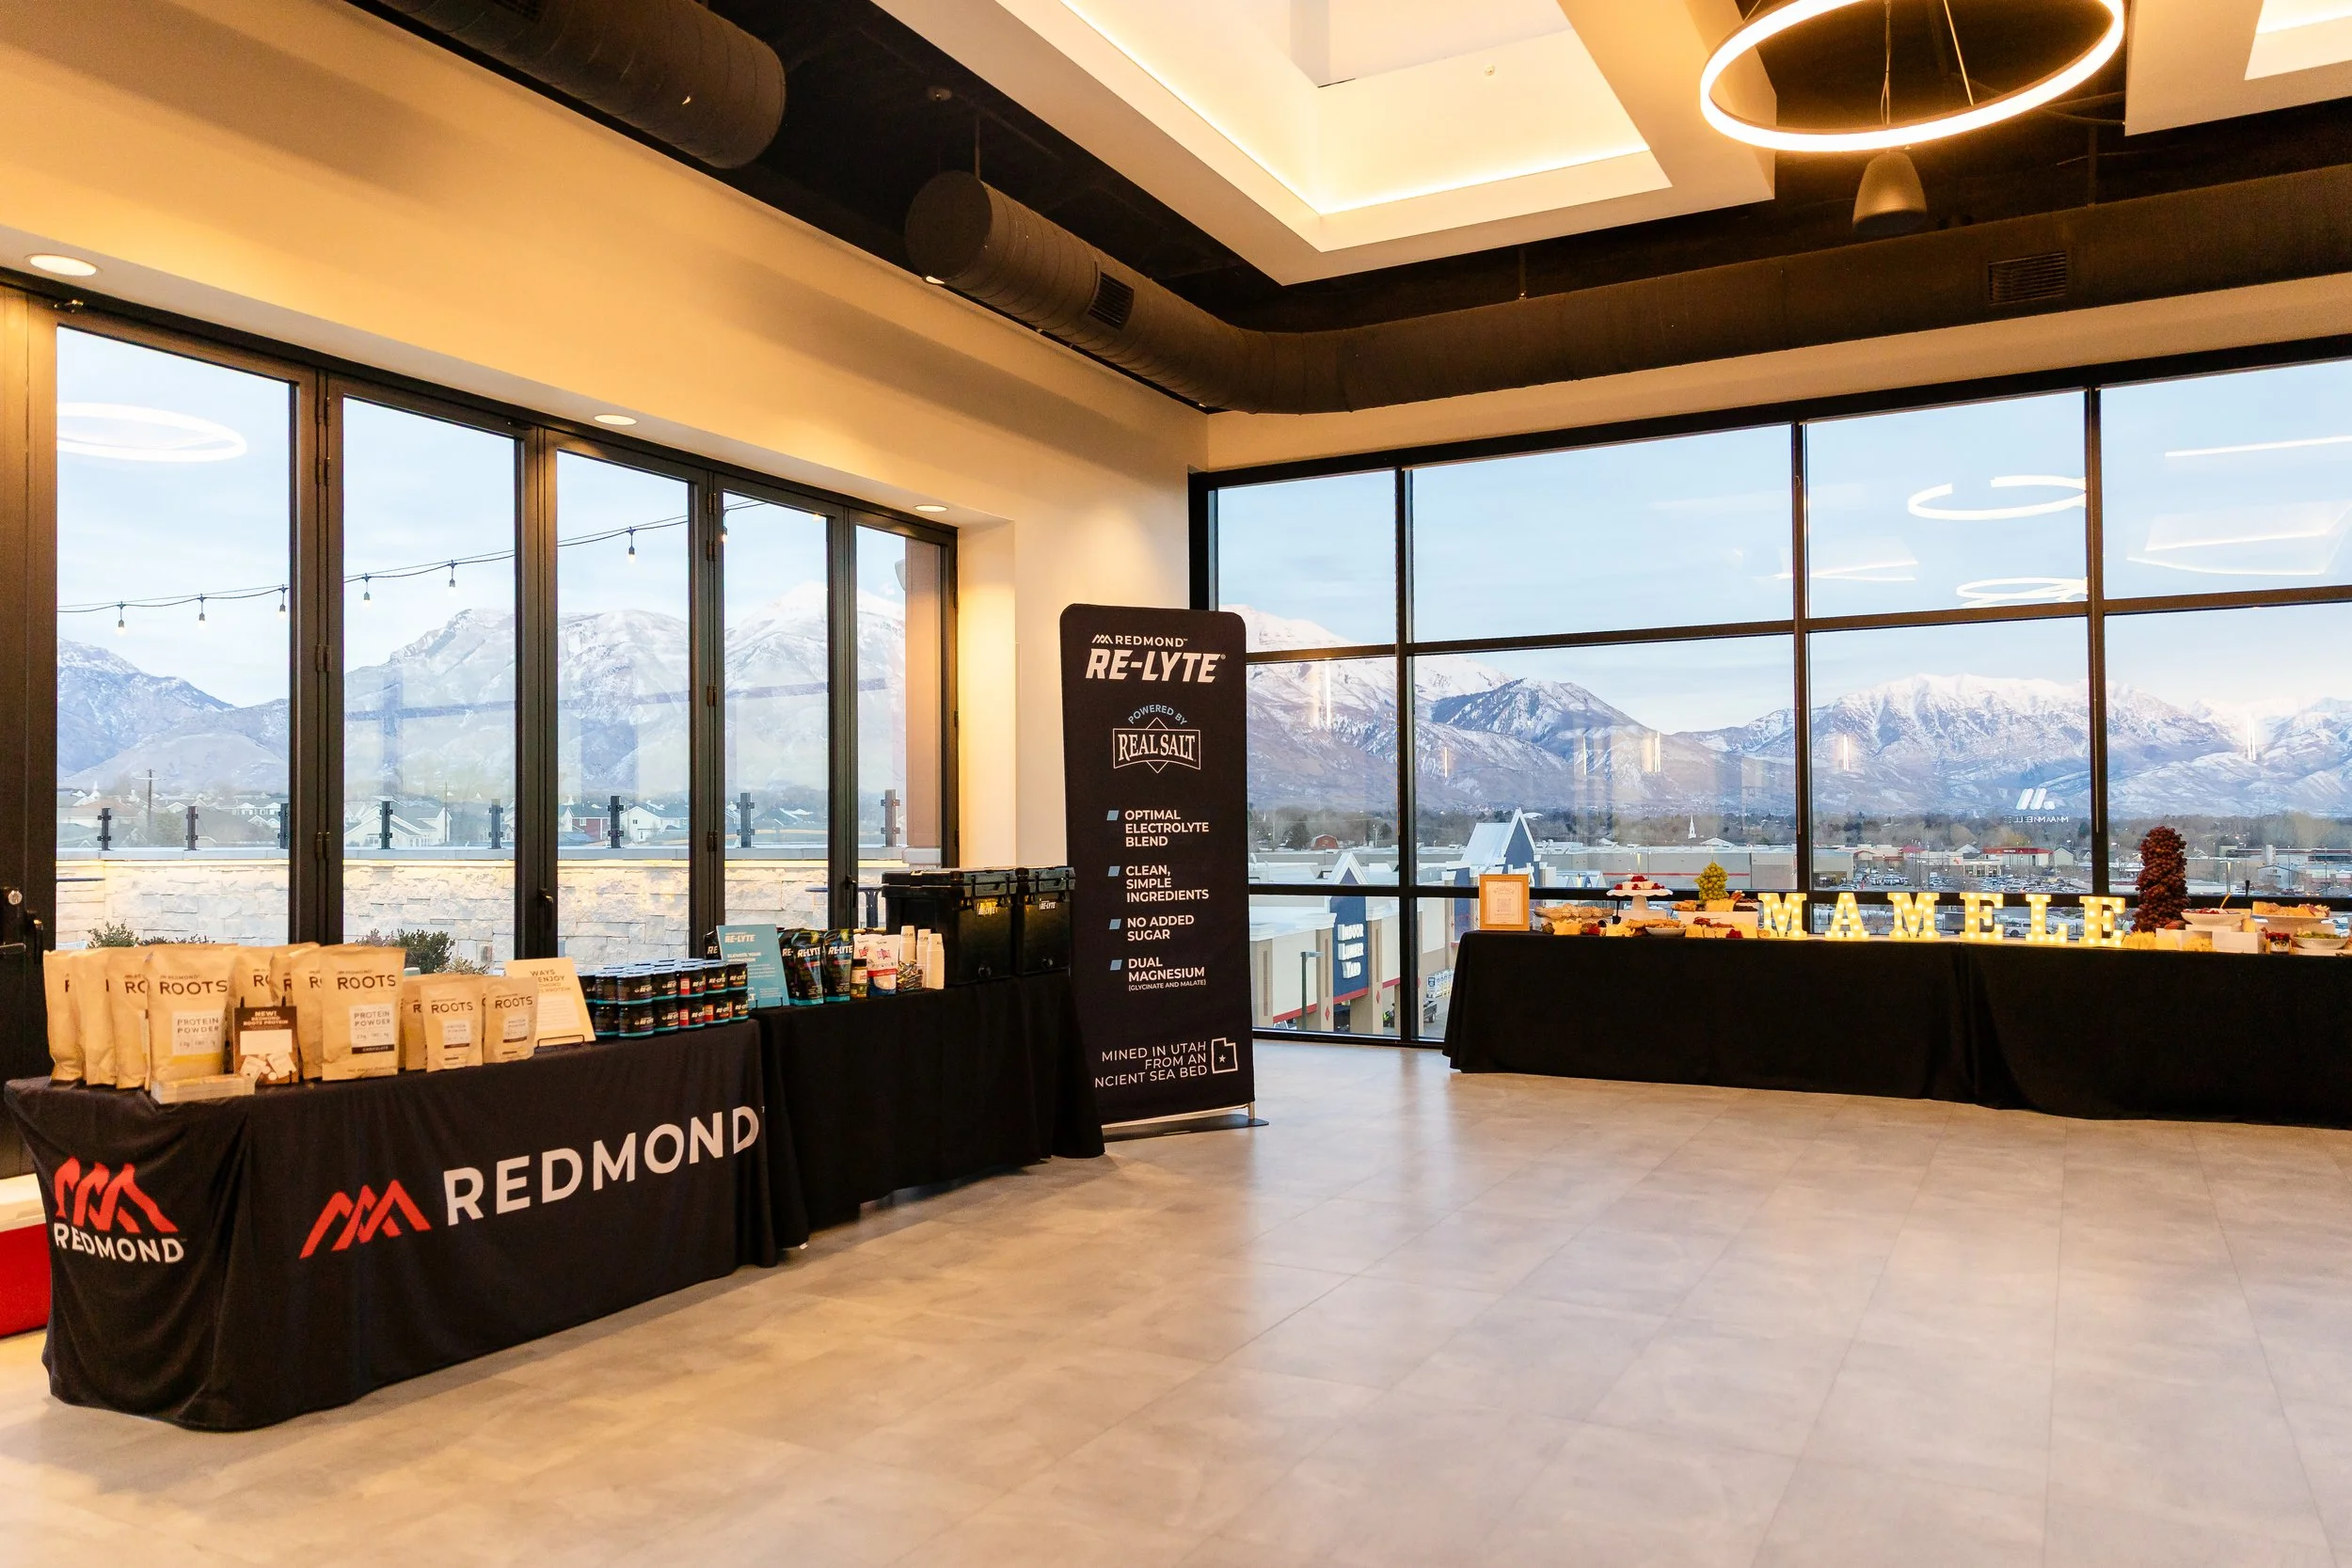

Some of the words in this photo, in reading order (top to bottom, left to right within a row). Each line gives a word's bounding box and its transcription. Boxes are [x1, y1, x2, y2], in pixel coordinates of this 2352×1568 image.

[1115, 635, 1184, 647] REDMOND
[1085, 648, 1221, 683] RE-LYTE
[1127, 704, 1174, 725] POWERED
[1174, 713, 1188, 725] BY
[1118, 734, 1159, 761] REAL
[1160, 735, 1195, 761] SALT
[1124, 810, 1181, 820] OPTIMAL
[1125, 822, 1210, 833] ELECTROLYTE
[1125, 836, 1168, 847] BLEND
[1125, 865, 1171, 877] CLEAN,
[1126, 878, 1171, 889] SIMPLE
[1126, 889, 1210, 903] INGREDIENTS
[1127, 917, 1147, 927] NO
[1149, 914, 1195, 927] ADDED
[1757, 893, 2126, 947] MAMELE
[724, 934, 755, 943] RE-LYTE
[1127, 929, 1170, 942] SUGAR
[1338, 924, 1364, 941] INDOOR
[828, 945, 853, 954] RE-LYTE
[1338, 942, 1364, 960] LUMBER
[1128, 957, 1163, 969] DUAL
[1342, 961, 1361, 978] YARD
[1128, 967, 1205, 982] MAGNESIUM
[159, 979, 228, 995] ROOTS
[337, 974, 396, 990] ROOTS
[1128, 982, 1165, 992] (GLYCINATE
[431, 1001, 473, 1014] ROOTS
[495, 996, 533, 1009] ROOTS
[177, 1017, 219, 1026] PROTEIN
[354, 1011, 390, 1020] PROTEIN
[1102, 1047, 1148, 1062] MINED
[1152, 1045, 1167, 1057] IN
[1170, 1041, 1207, 1054] UTAH
[1145, 1056, 1184, 1070] FROM
[1187, 1053, 1207, 1065] AN
[1094, 1071, 1146, 1088] NCIENT
[1150, 1069, 1176, 1082] SEA
[1180, 1065, 1208, 1078] BED
[443, 1105, 760, 1227] REDMOND
[54, 1222, 185, 1264] REDMOND
